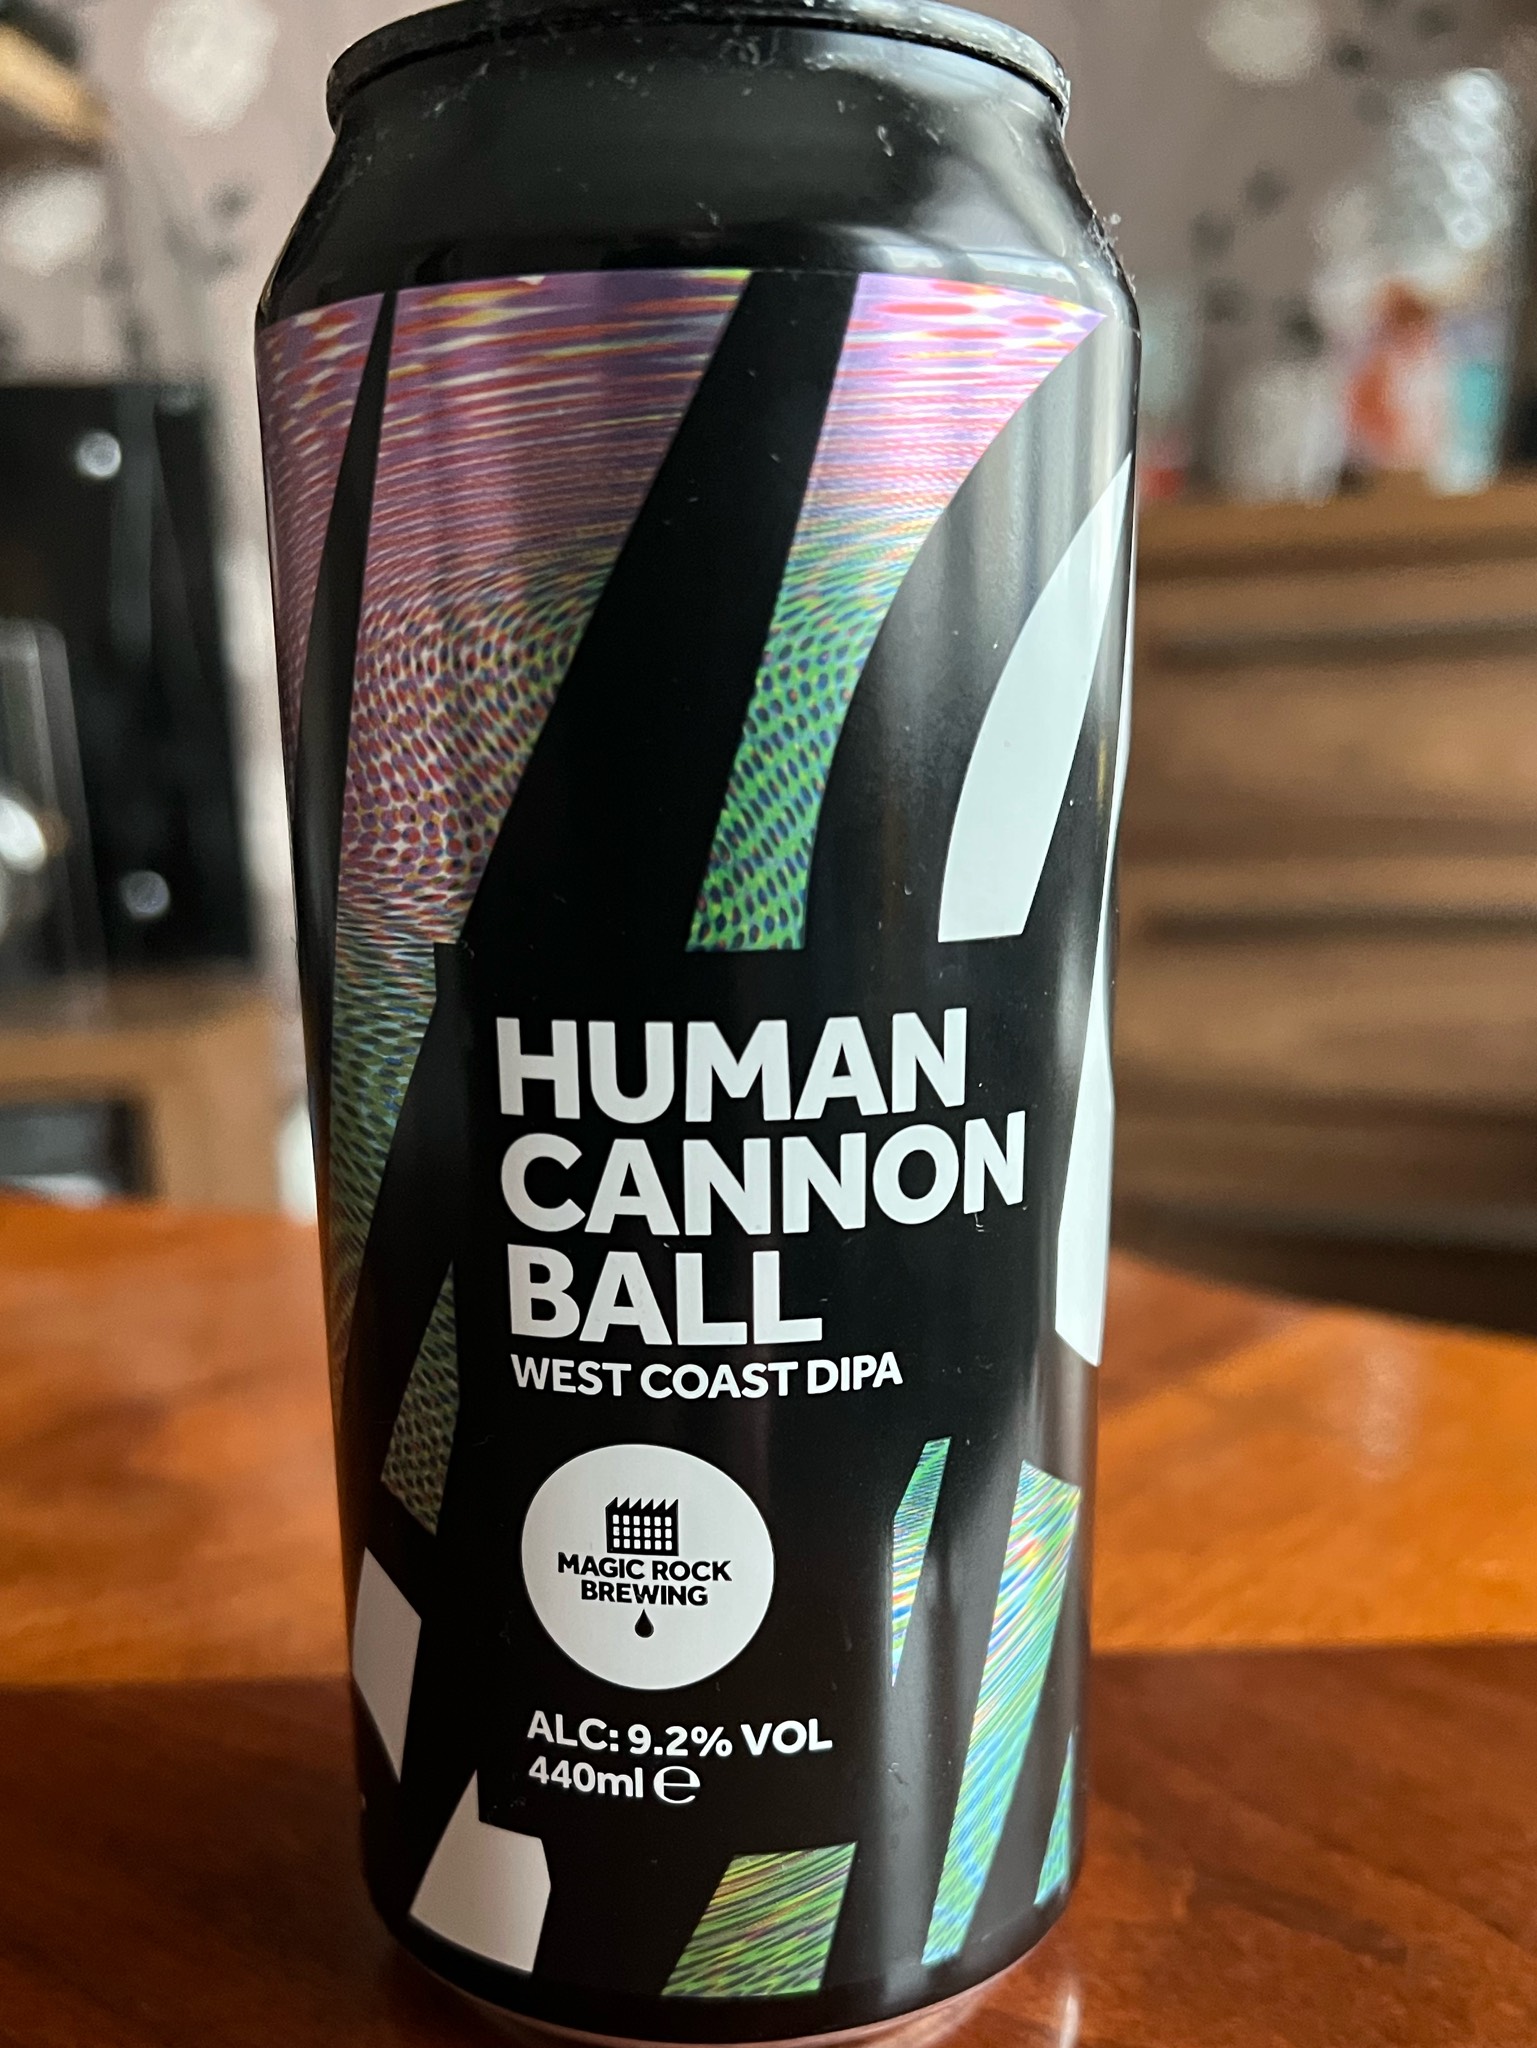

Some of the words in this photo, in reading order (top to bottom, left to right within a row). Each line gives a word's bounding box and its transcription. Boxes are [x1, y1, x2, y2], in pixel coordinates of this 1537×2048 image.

[496, 1007, 968, 1124] HUMAN
[501, 1110, 1026, 1236] CANNON
[507, 1243, 823, 1346] BALL
[511, 1353, 632, 1397] WEST
[640, 1361, 799, 1400] COAST
[807, 1351, 904, 1395] DIPA
[557, 1551, 645, 1580] MAGIC
[651, 1559, 733, 1582] ROCK
[580, 1581, 709, 1607] BREWING
[527, 1710, 619, 1752] ALC:
[627, 1723, 733, 1758] 9.2%
[740, 1718, 833, 1756] VOL
[528, 1755, 644, 1799] 440ml
